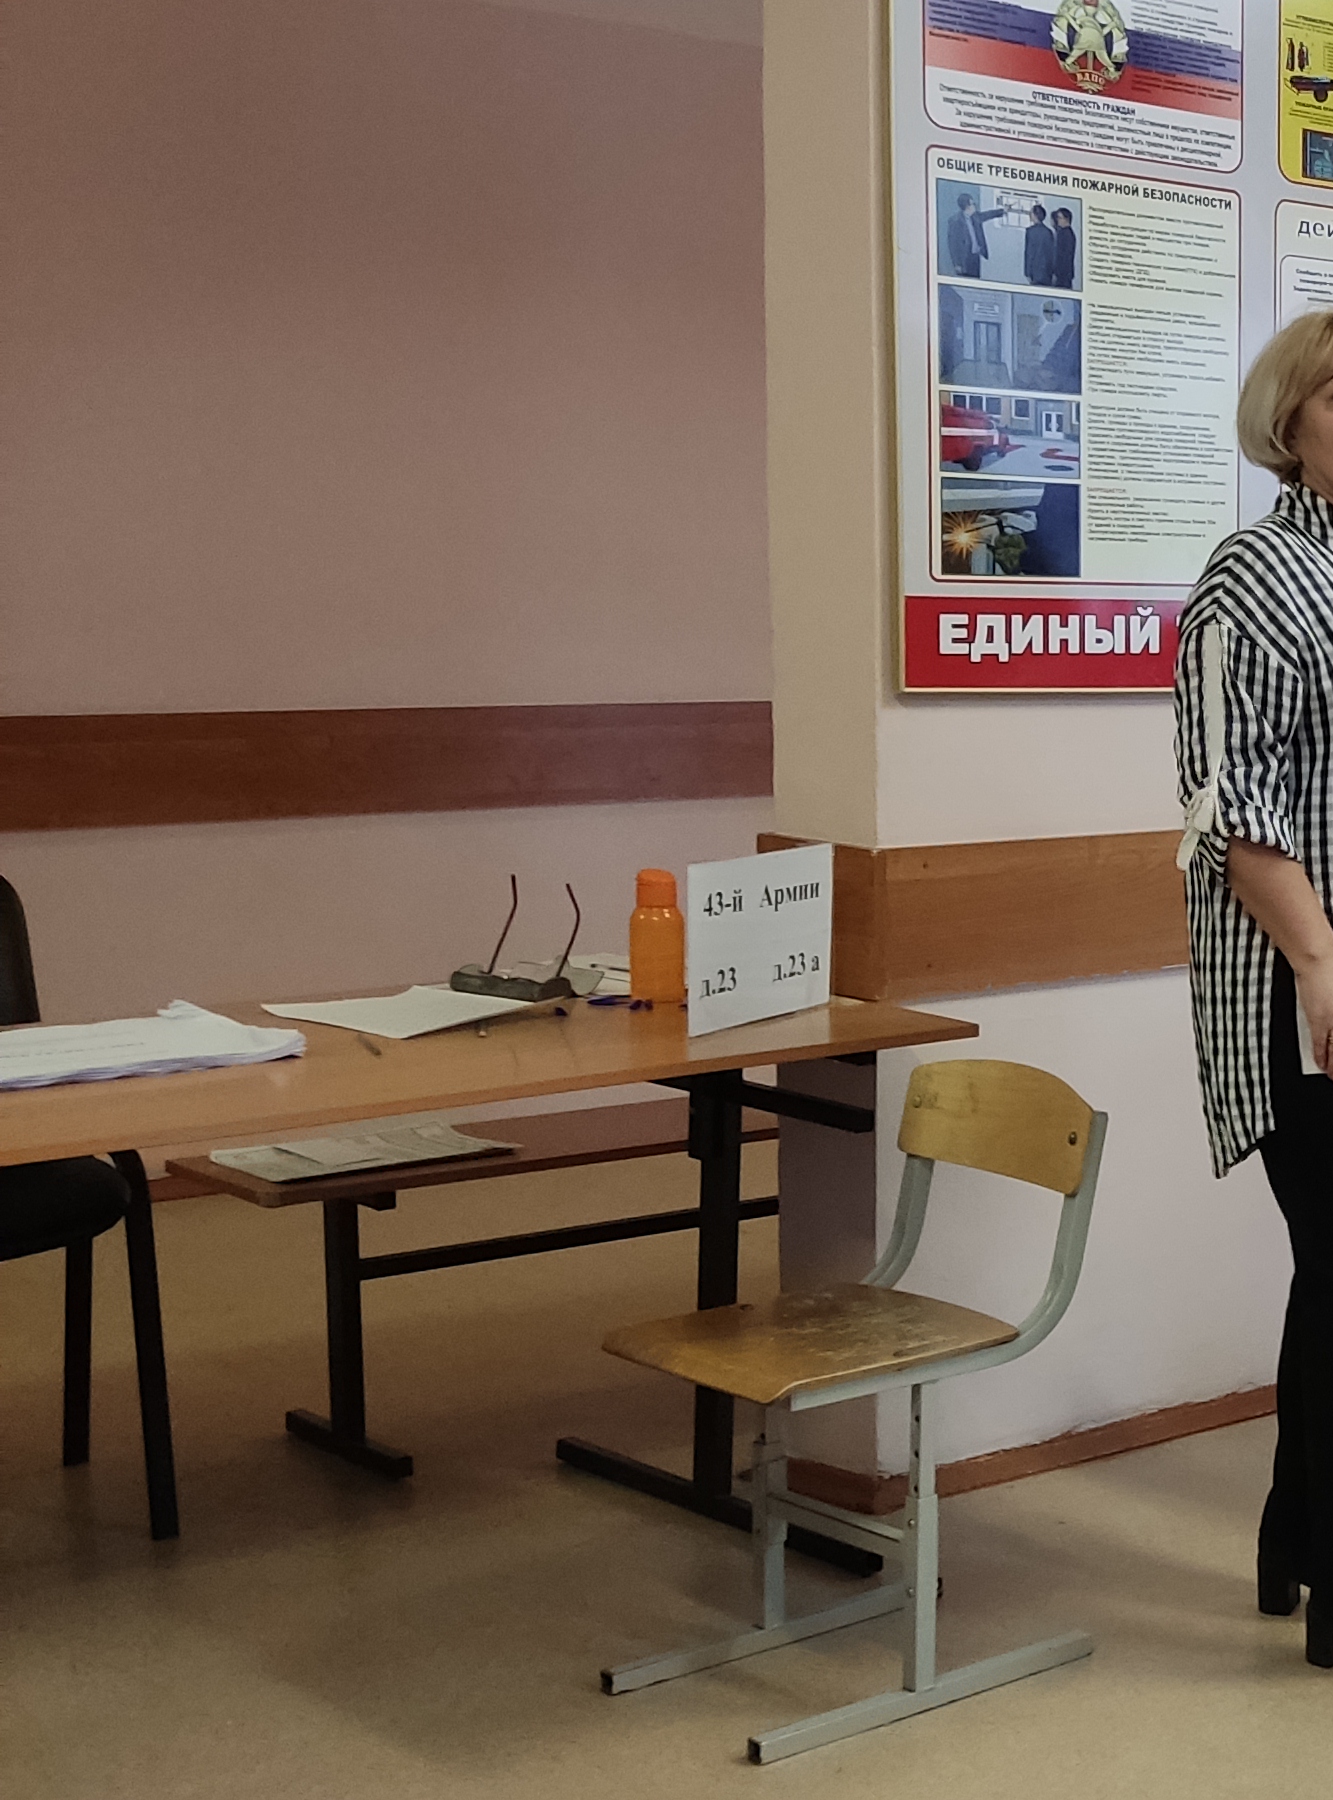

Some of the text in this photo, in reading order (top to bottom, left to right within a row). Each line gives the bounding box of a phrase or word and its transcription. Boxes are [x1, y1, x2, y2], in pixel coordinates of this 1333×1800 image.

[1032, 90, 1136, 116] ОТВЕТСТВЕННОСТЬ ГРАЖДАН
[937, 156, 1232, 210] ОБЩИЕ ТРЕБОВАНИЯ ПОЖАРНОЙ БЕЗОПАСНОСТИ
[938, 606, 1161, 661] ЕДИНЫЙ
[703, 881, 820, 917] 43-й Армии
[699, 952, 820, 999] д.23 д.23 а
